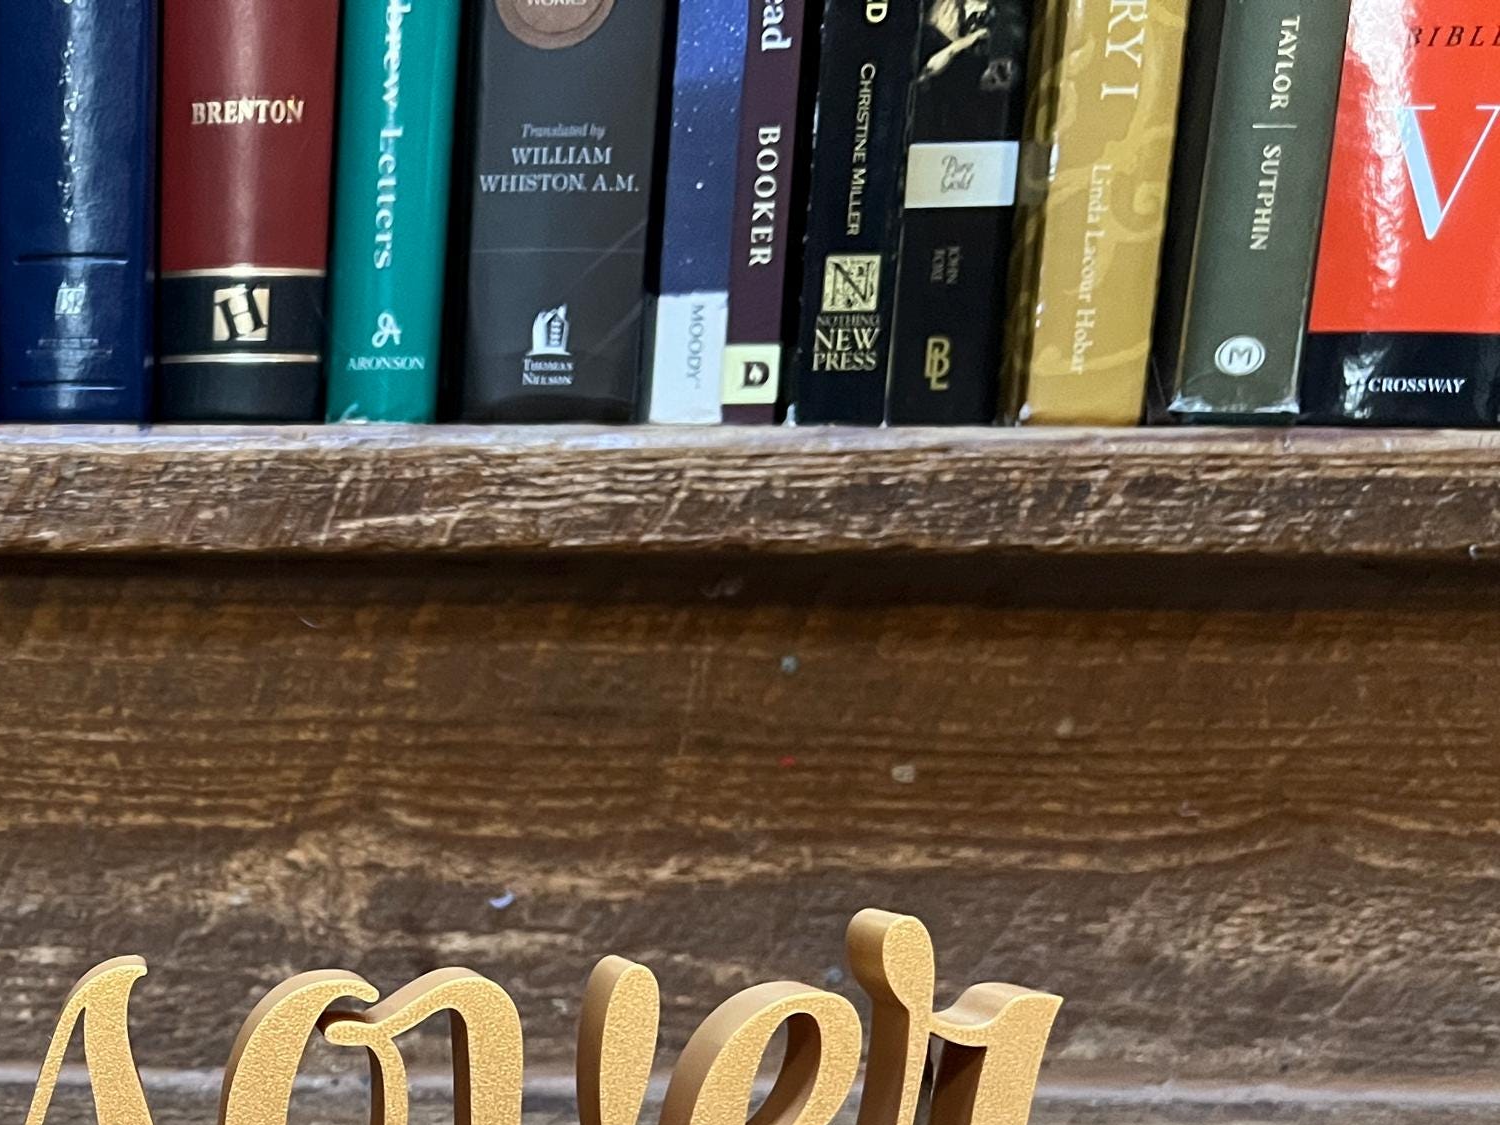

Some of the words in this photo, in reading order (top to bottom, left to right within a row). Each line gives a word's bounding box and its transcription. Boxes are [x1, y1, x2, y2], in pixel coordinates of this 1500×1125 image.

[761, 0, 792, 51] ad
[1270, 15, 1301, 110] TAYLOR
[191, 96, 304, 126] BRENTON
[1100, 82, 1139, 100] I
[521, 123, 587, 138] Translated
[852, 63, 876, 163] CHRISTINE
[511, 146, 612, 165] WILLIAM
[592, 173, 640, 192] A.M.
[748, 124, 781, 267] BOOKER
[847, 168, 867, 236] MILLER
[1087, 164, 1112, 224] Linda
[1250, 144, 1282, 250] SUTPHIN
[1078, 230, 1105, 302] Lacour
[686, 304, 704, 380] MOODY
[814, 328, 880, 351] NEW
[346, 356, 425, 370] ARONSON
[812, 352, 877, 371] PRESS
[1368, 377, 1466, 394] CROSSWAY
